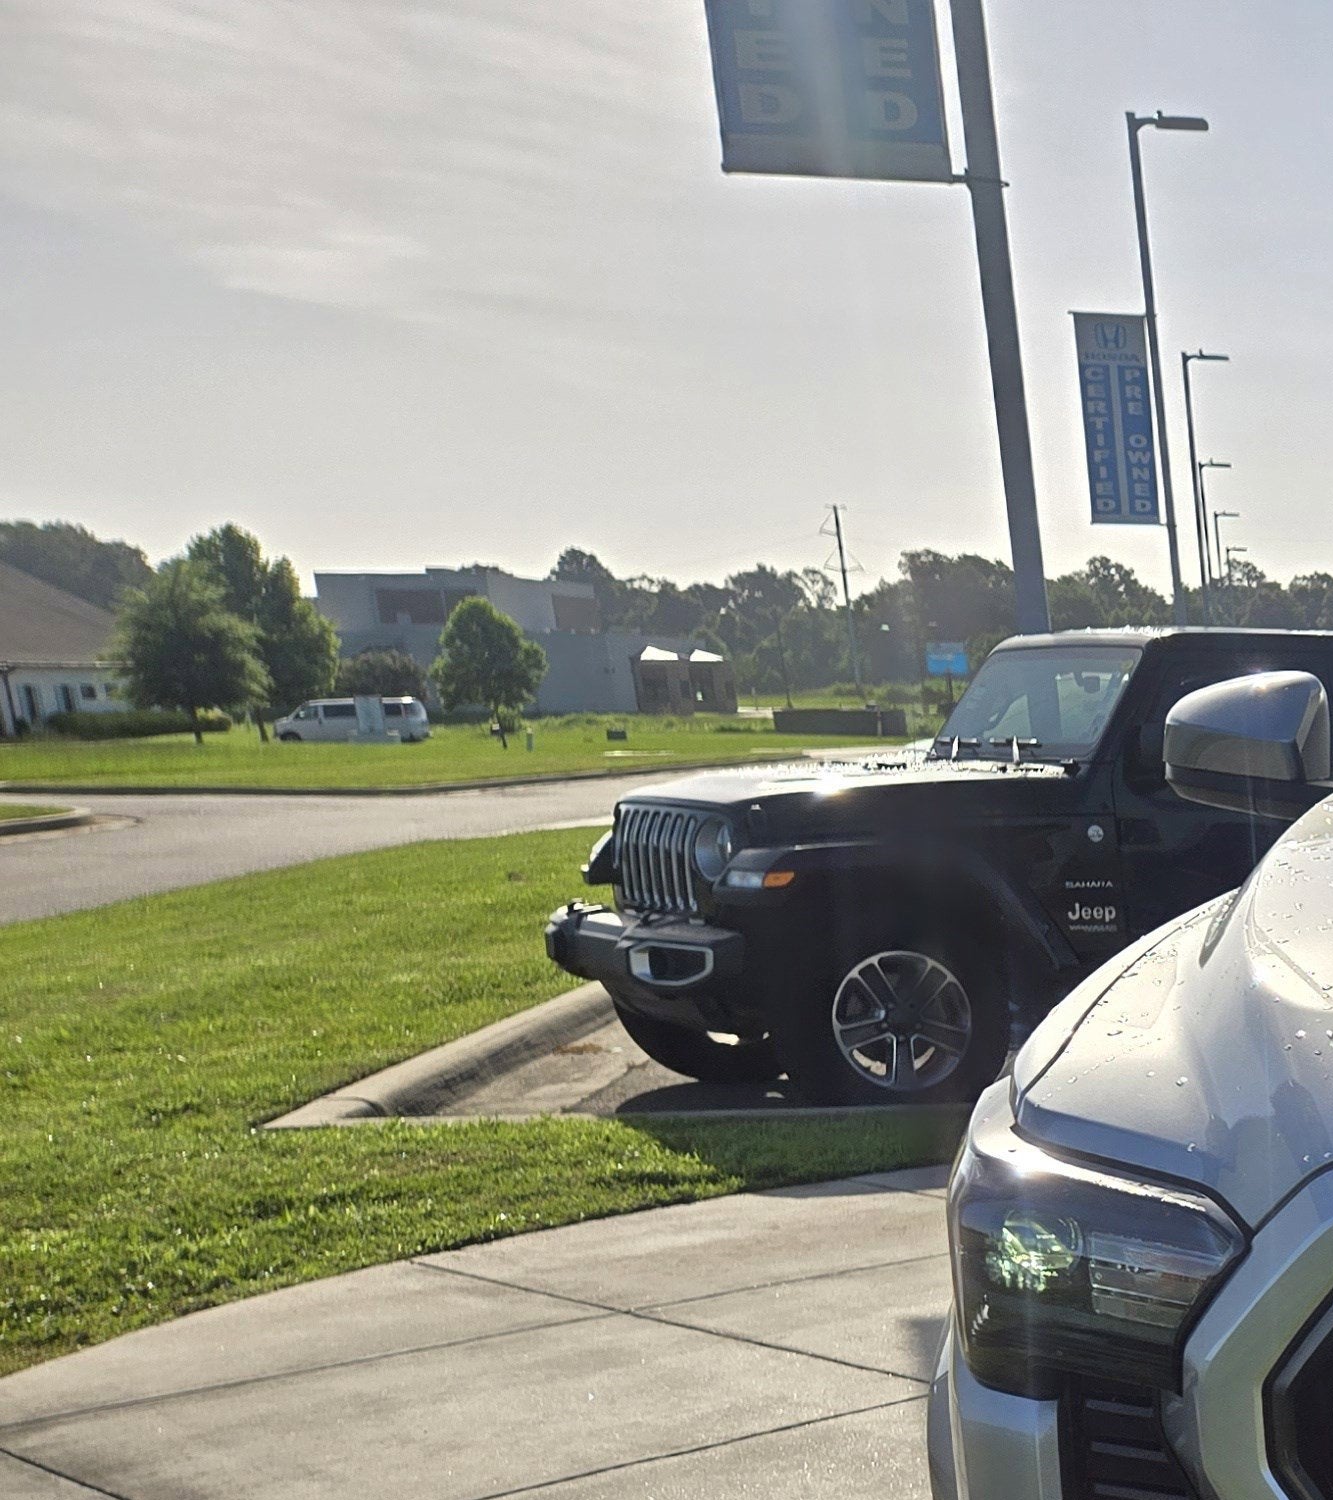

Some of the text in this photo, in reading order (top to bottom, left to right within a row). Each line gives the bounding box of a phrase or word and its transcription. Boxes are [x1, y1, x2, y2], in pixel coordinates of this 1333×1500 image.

[1084, 366, 1117, 512] CERTIFIED
[1127, 433, 1152, 512] OWNED
[1067, 902, 1117, 922] Jeep
